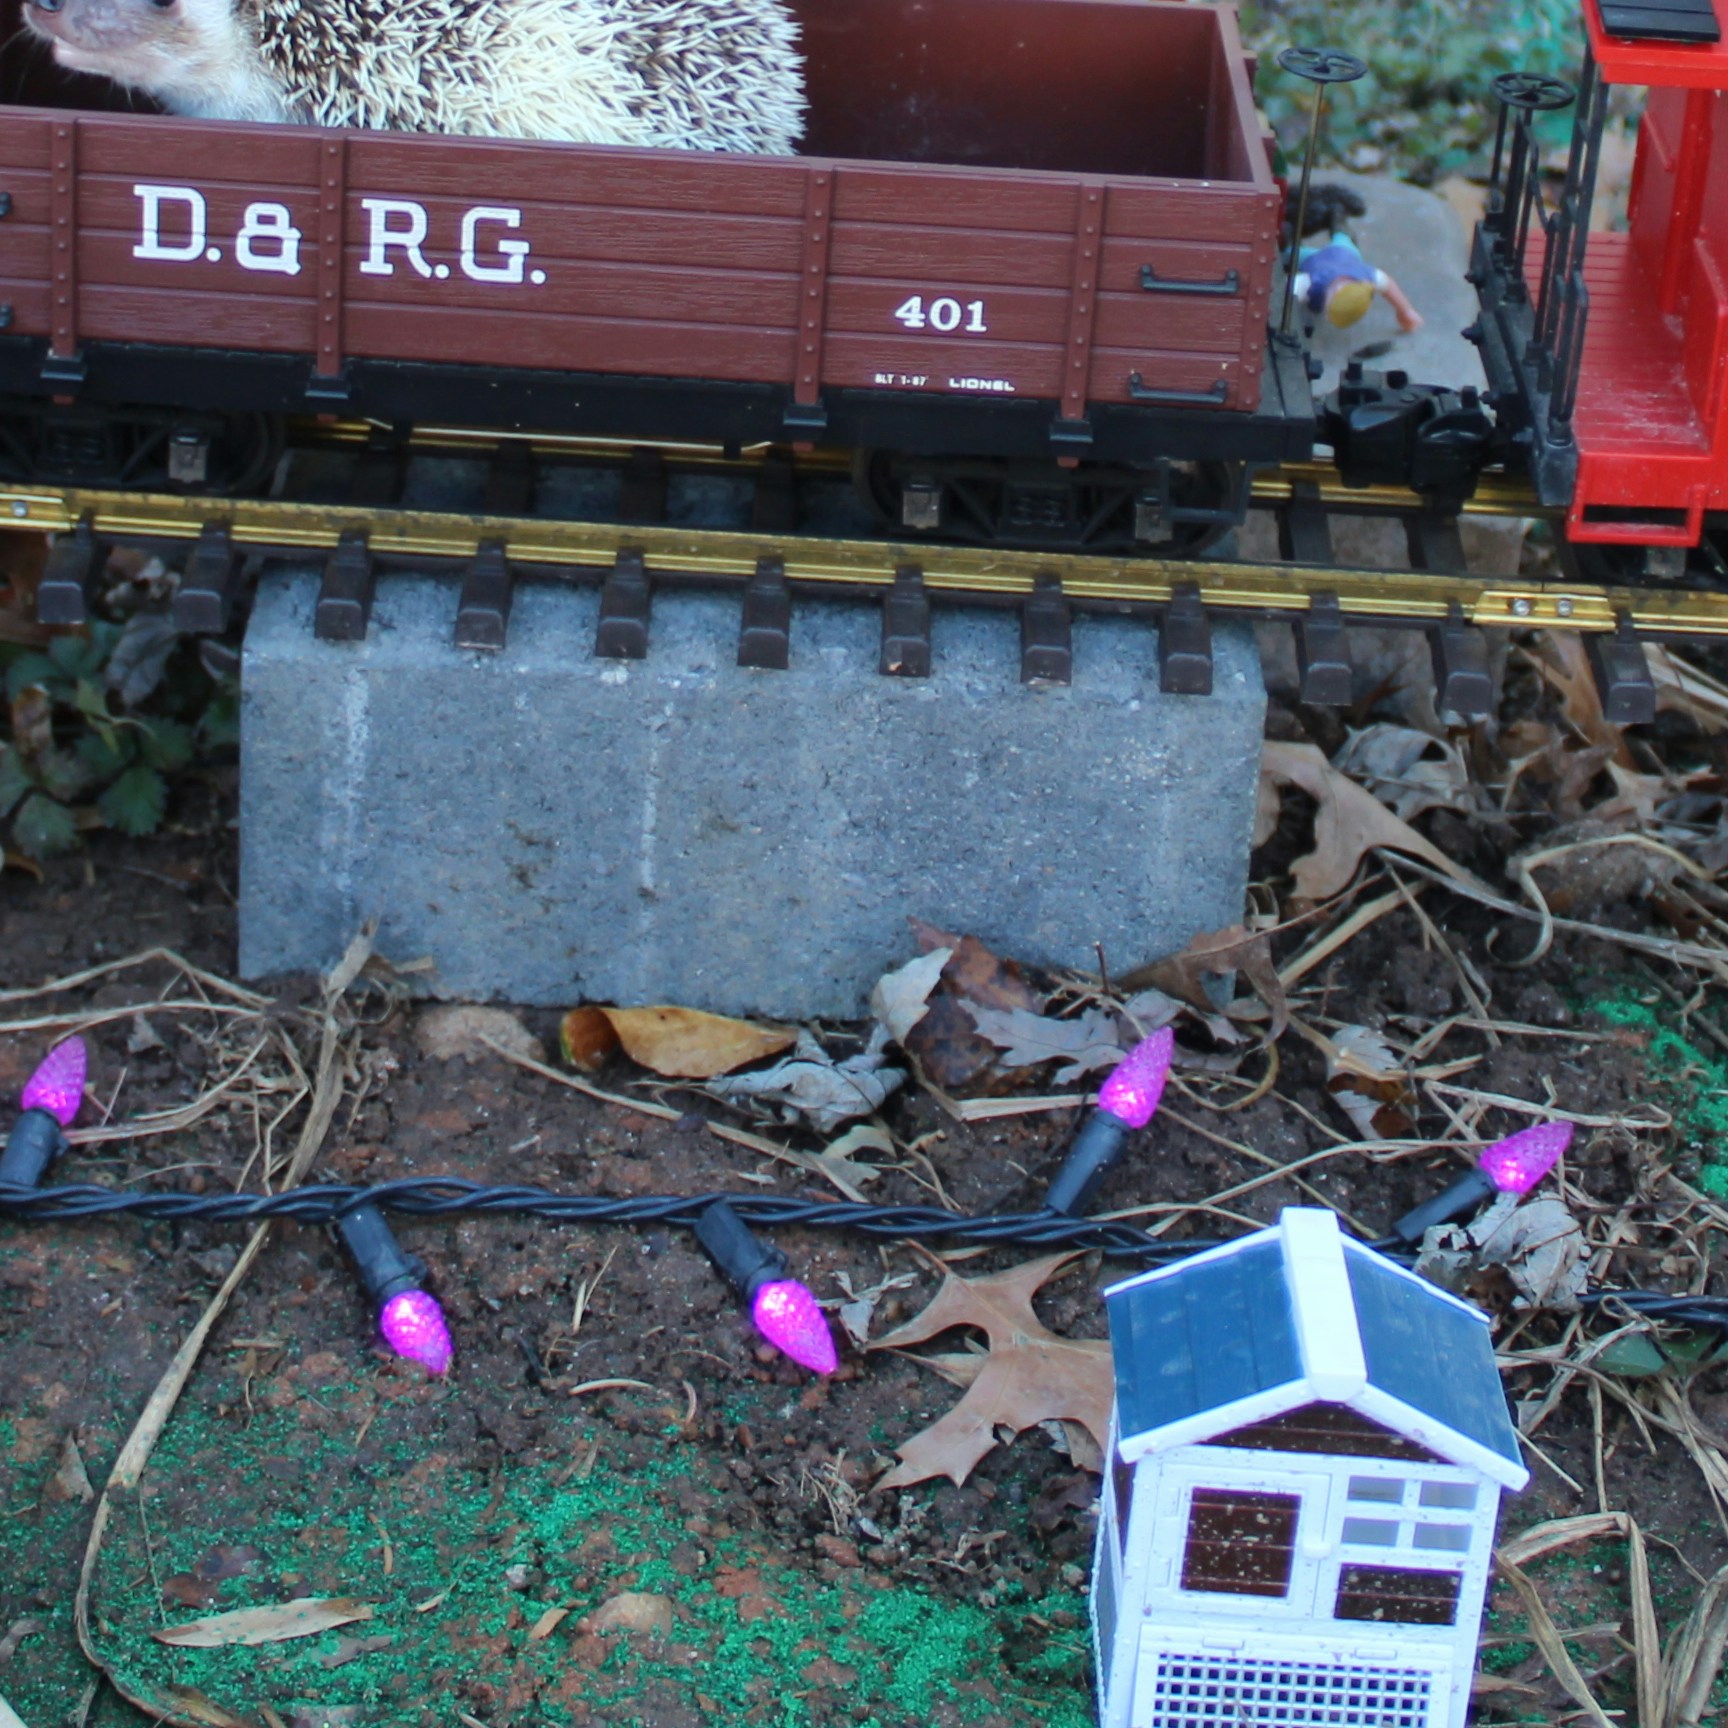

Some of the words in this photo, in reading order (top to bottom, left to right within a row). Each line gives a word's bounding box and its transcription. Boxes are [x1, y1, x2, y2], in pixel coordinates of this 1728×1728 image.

[894, 295, 987, 332] 401
[874, 373, 895, 384] BLT
[948, 377, 1016, 392] LIONEL
